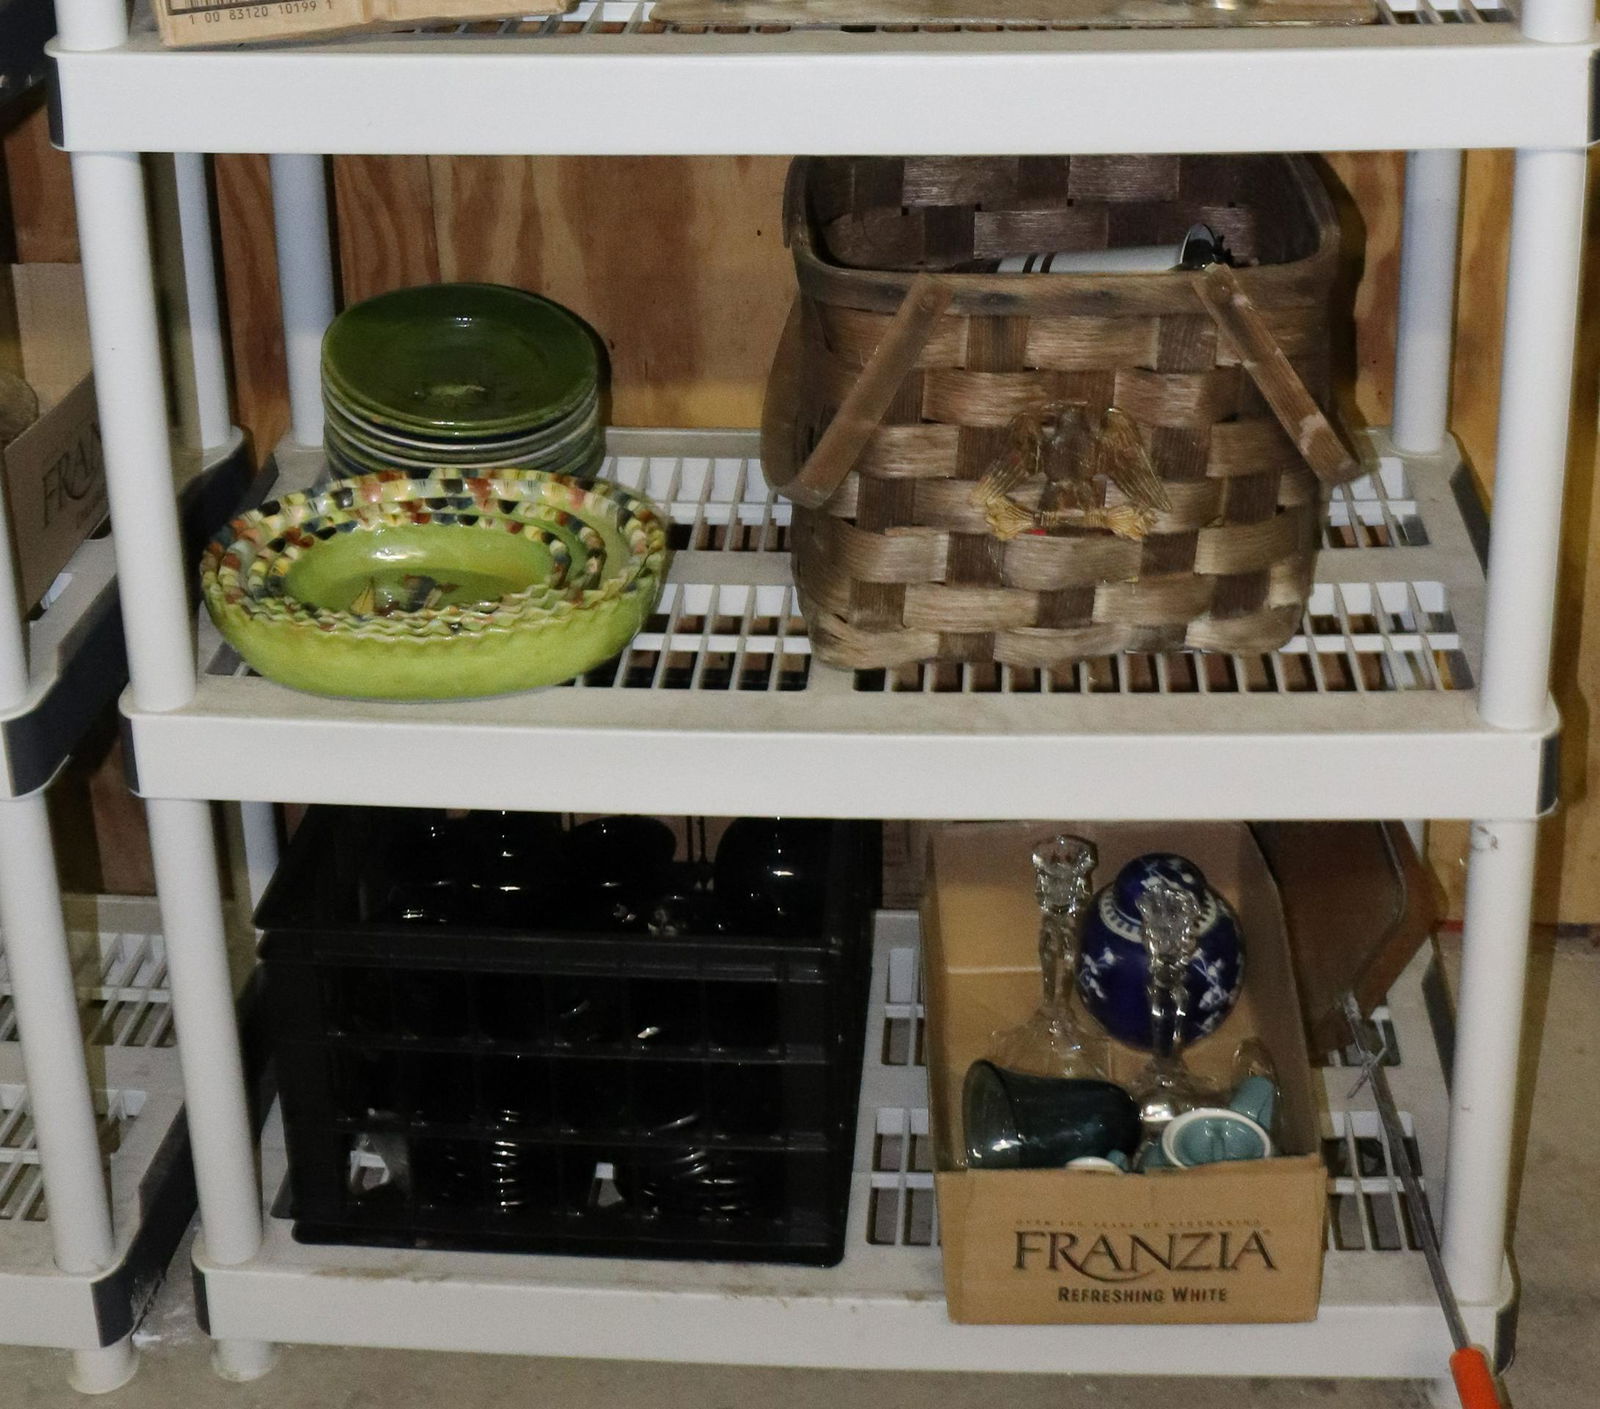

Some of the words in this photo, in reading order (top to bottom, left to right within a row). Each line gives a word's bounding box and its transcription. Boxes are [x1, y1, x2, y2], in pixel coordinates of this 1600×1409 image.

[204, 11, 220, 24] 00
[228, 5, 269, 21] 83120
[278, 1, 317, 15] 10199
[1012, 1228, 1278, 1283] FRANZIA
[1058, 1286, 1165, 1304] REFRESHING
[1172, 1286, 1228, 1303] WHITE
